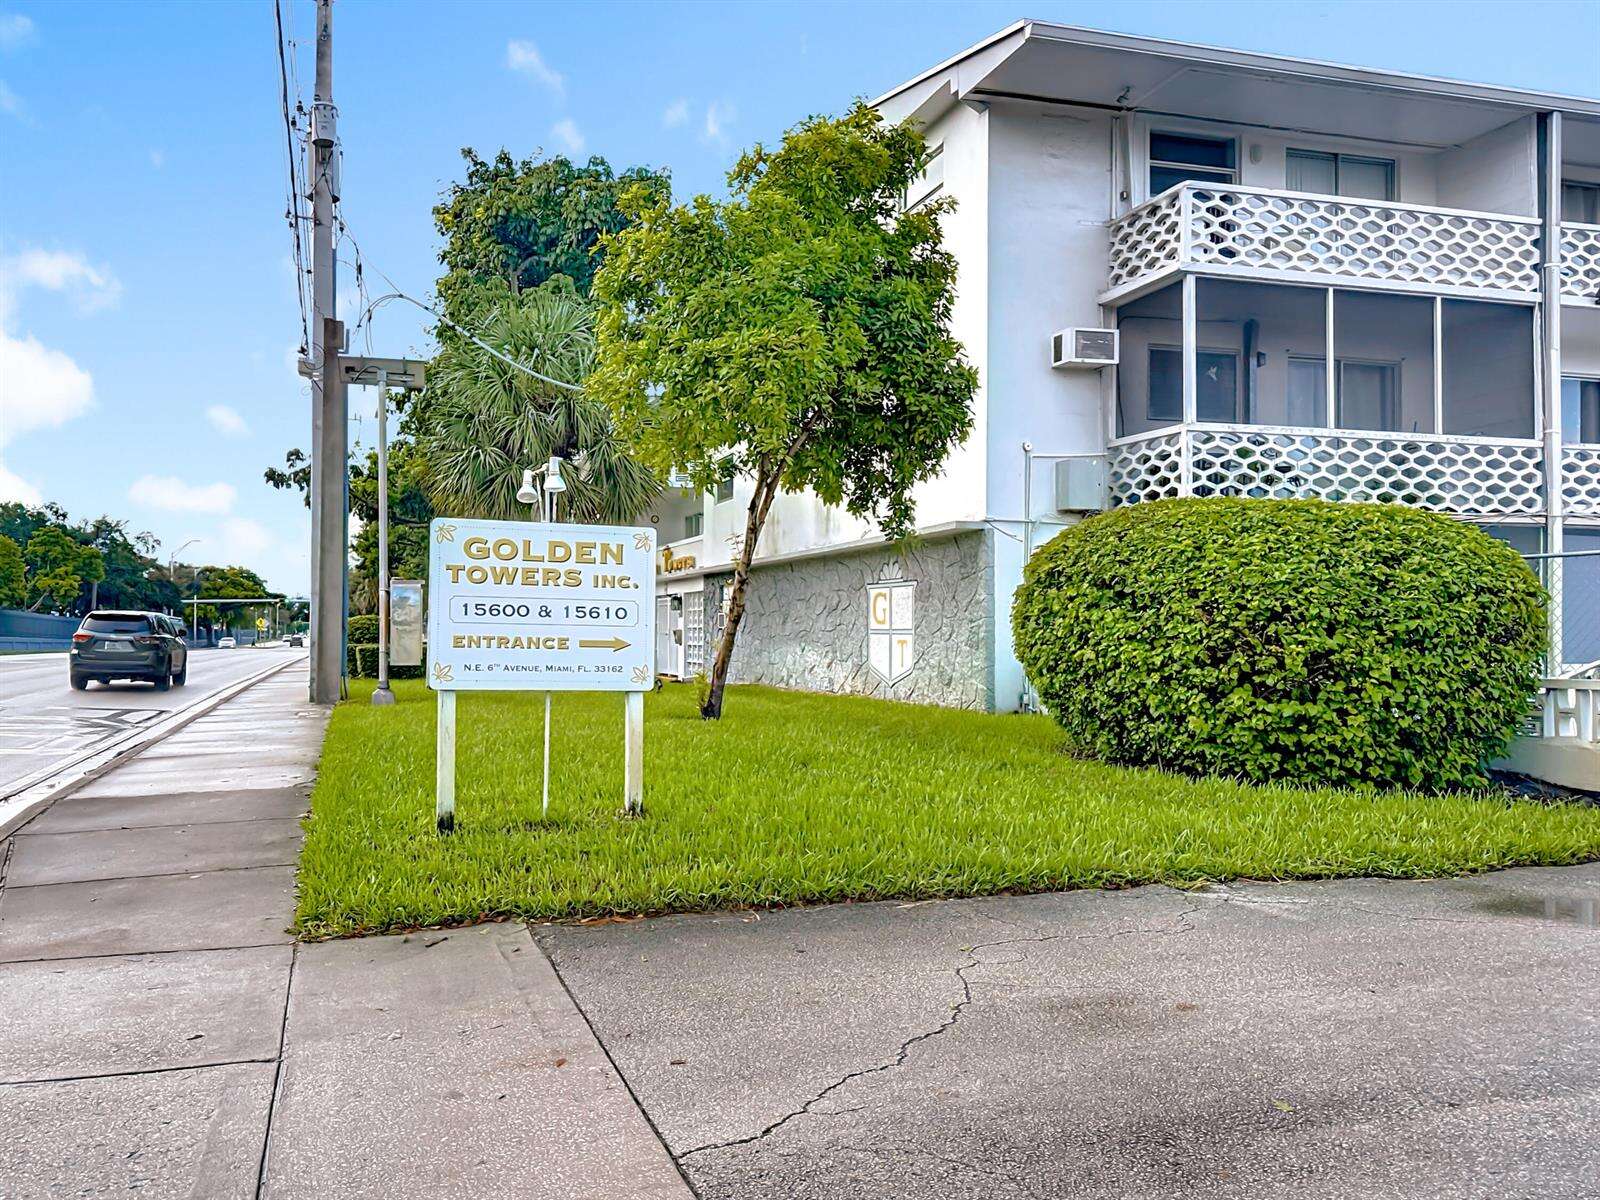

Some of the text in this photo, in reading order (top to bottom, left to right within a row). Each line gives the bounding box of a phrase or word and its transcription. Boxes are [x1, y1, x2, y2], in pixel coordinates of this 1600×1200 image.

[463, 537, 625, 566] GOLDEN
[446, 564, 640, 590] TOWERS INC.
[462, 603, 628, 620] 15600 & 15610
[873, 592, 887, 624] G
[452, 635, 570, 650] ENTRANCE
[897, 639, 908, 668] T
[463, 663, 624, 674] N.E. 6TH AVENUE, MIAMI, FL. 33162
